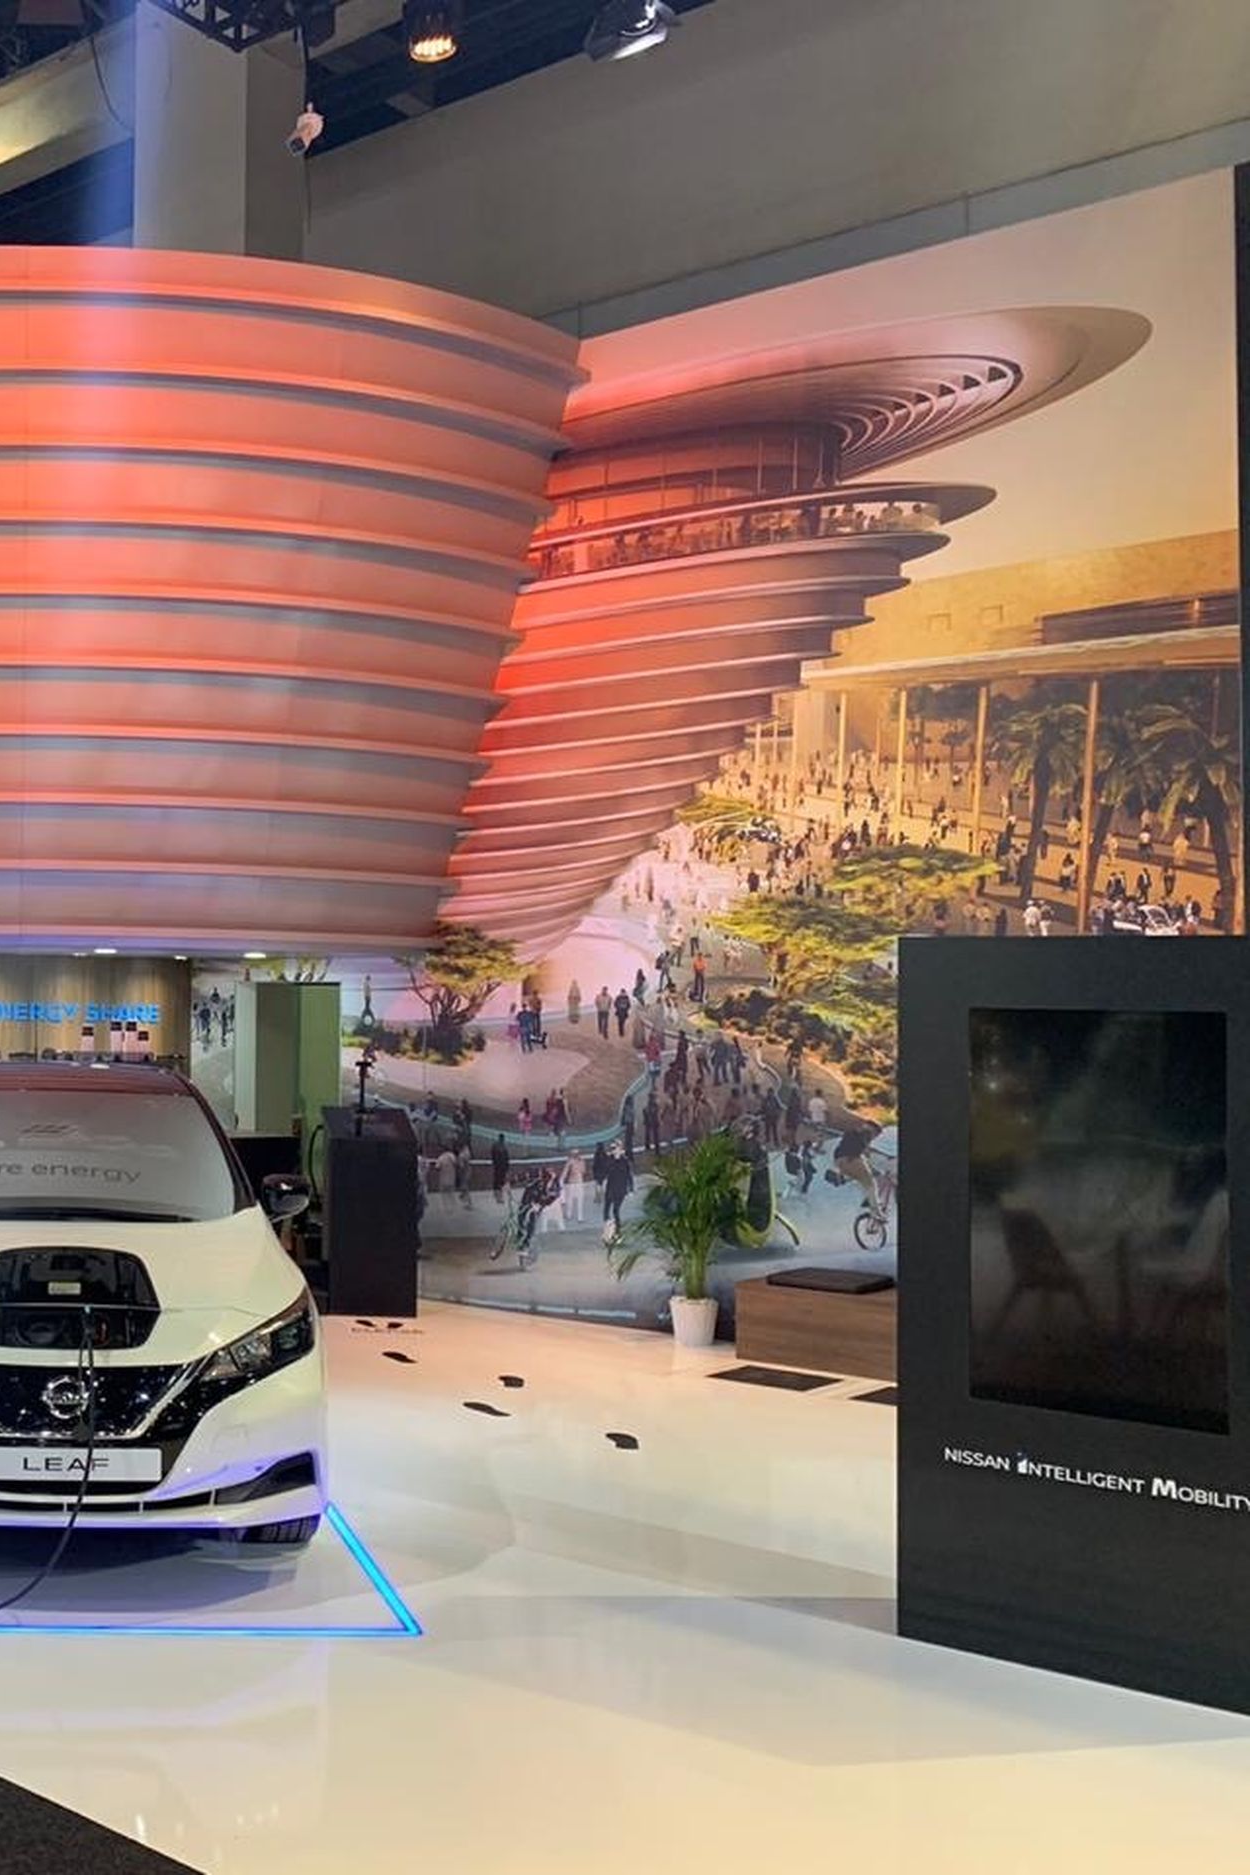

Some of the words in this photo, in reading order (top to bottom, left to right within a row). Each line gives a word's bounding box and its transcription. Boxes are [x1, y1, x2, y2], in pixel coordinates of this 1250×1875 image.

[85, 1002, 159, 1024] SHARE
[30, 1163, 142, 1184] energy
[23, 1456, 110, 1472] LEAF
[944, 1447, 1010, 1472] NISSAN
